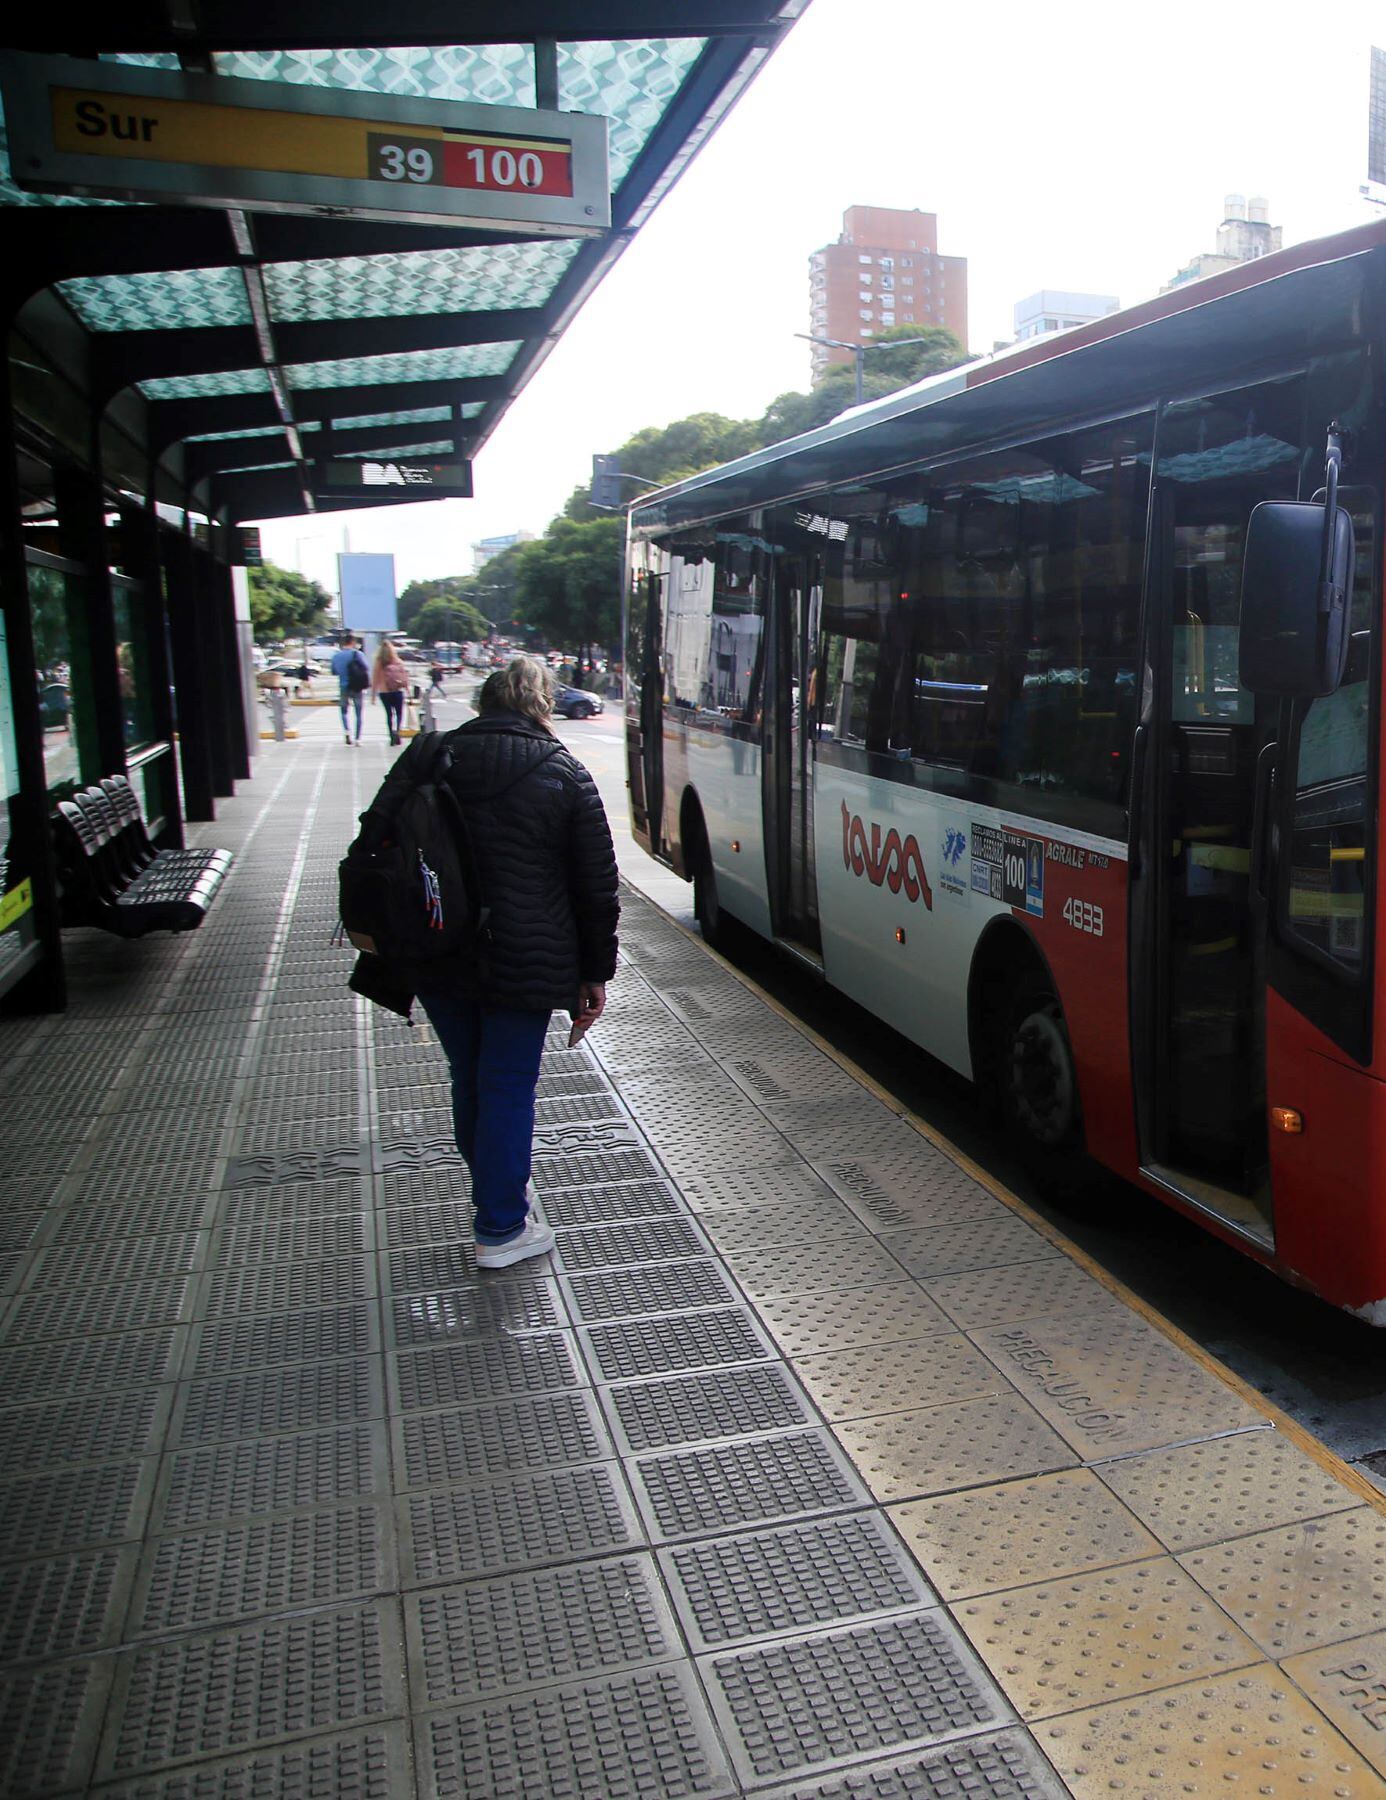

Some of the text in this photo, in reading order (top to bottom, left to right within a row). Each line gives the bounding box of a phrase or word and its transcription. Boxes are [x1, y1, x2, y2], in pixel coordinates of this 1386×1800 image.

[75, 101, 159, 142] Sur
[379, 145, 543, 187] 39 100
[1004, 853, 1025, 890] 100
[1046, 841, 1085, 869] AGRALE
[1063, 897, 1103, 937] 4833
[828, 1162, 914, 1226] PRECAUCIÓN
[991, 1330, 1130, 1445] PRECAUCIÓN
